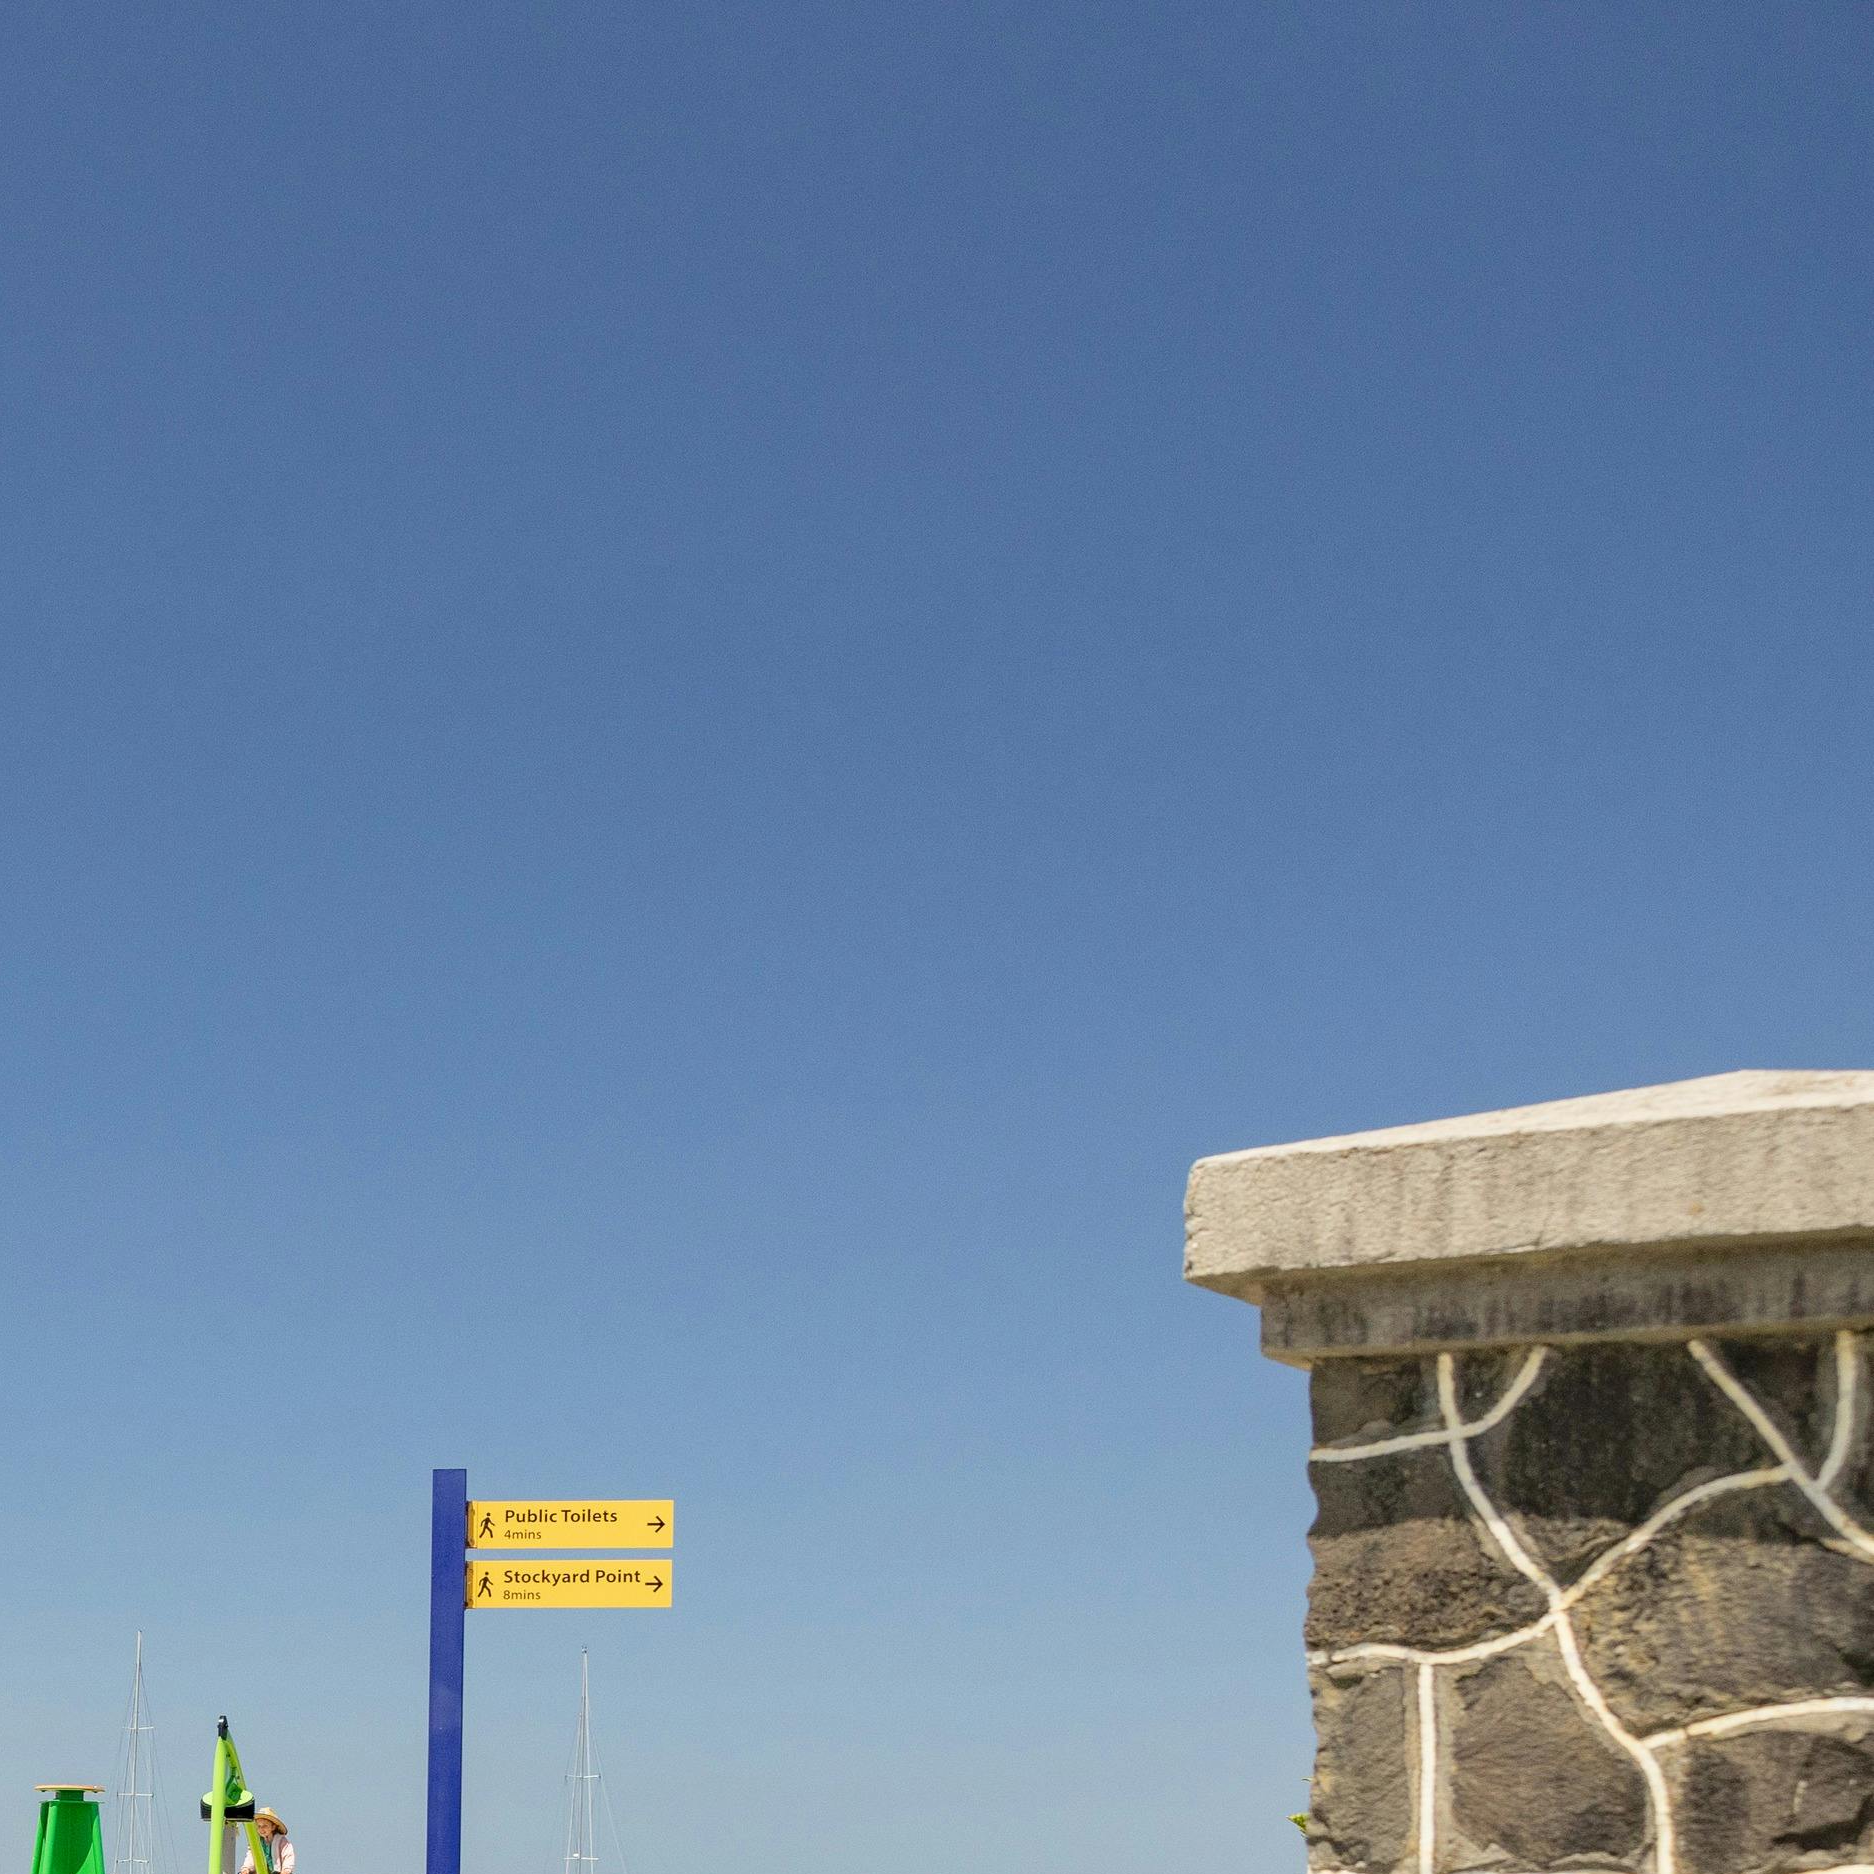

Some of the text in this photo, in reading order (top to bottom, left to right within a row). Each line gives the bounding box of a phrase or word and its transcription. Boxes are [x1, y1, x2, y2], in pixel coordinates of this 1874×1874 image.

[504, 1509, 618, 1523] Public Toilets
[504, 1529, 542, 1540] 4mins
[503, 1569, 641, 1586] Stockyard Point
[503, 1590, 541, 1600] 8mins
